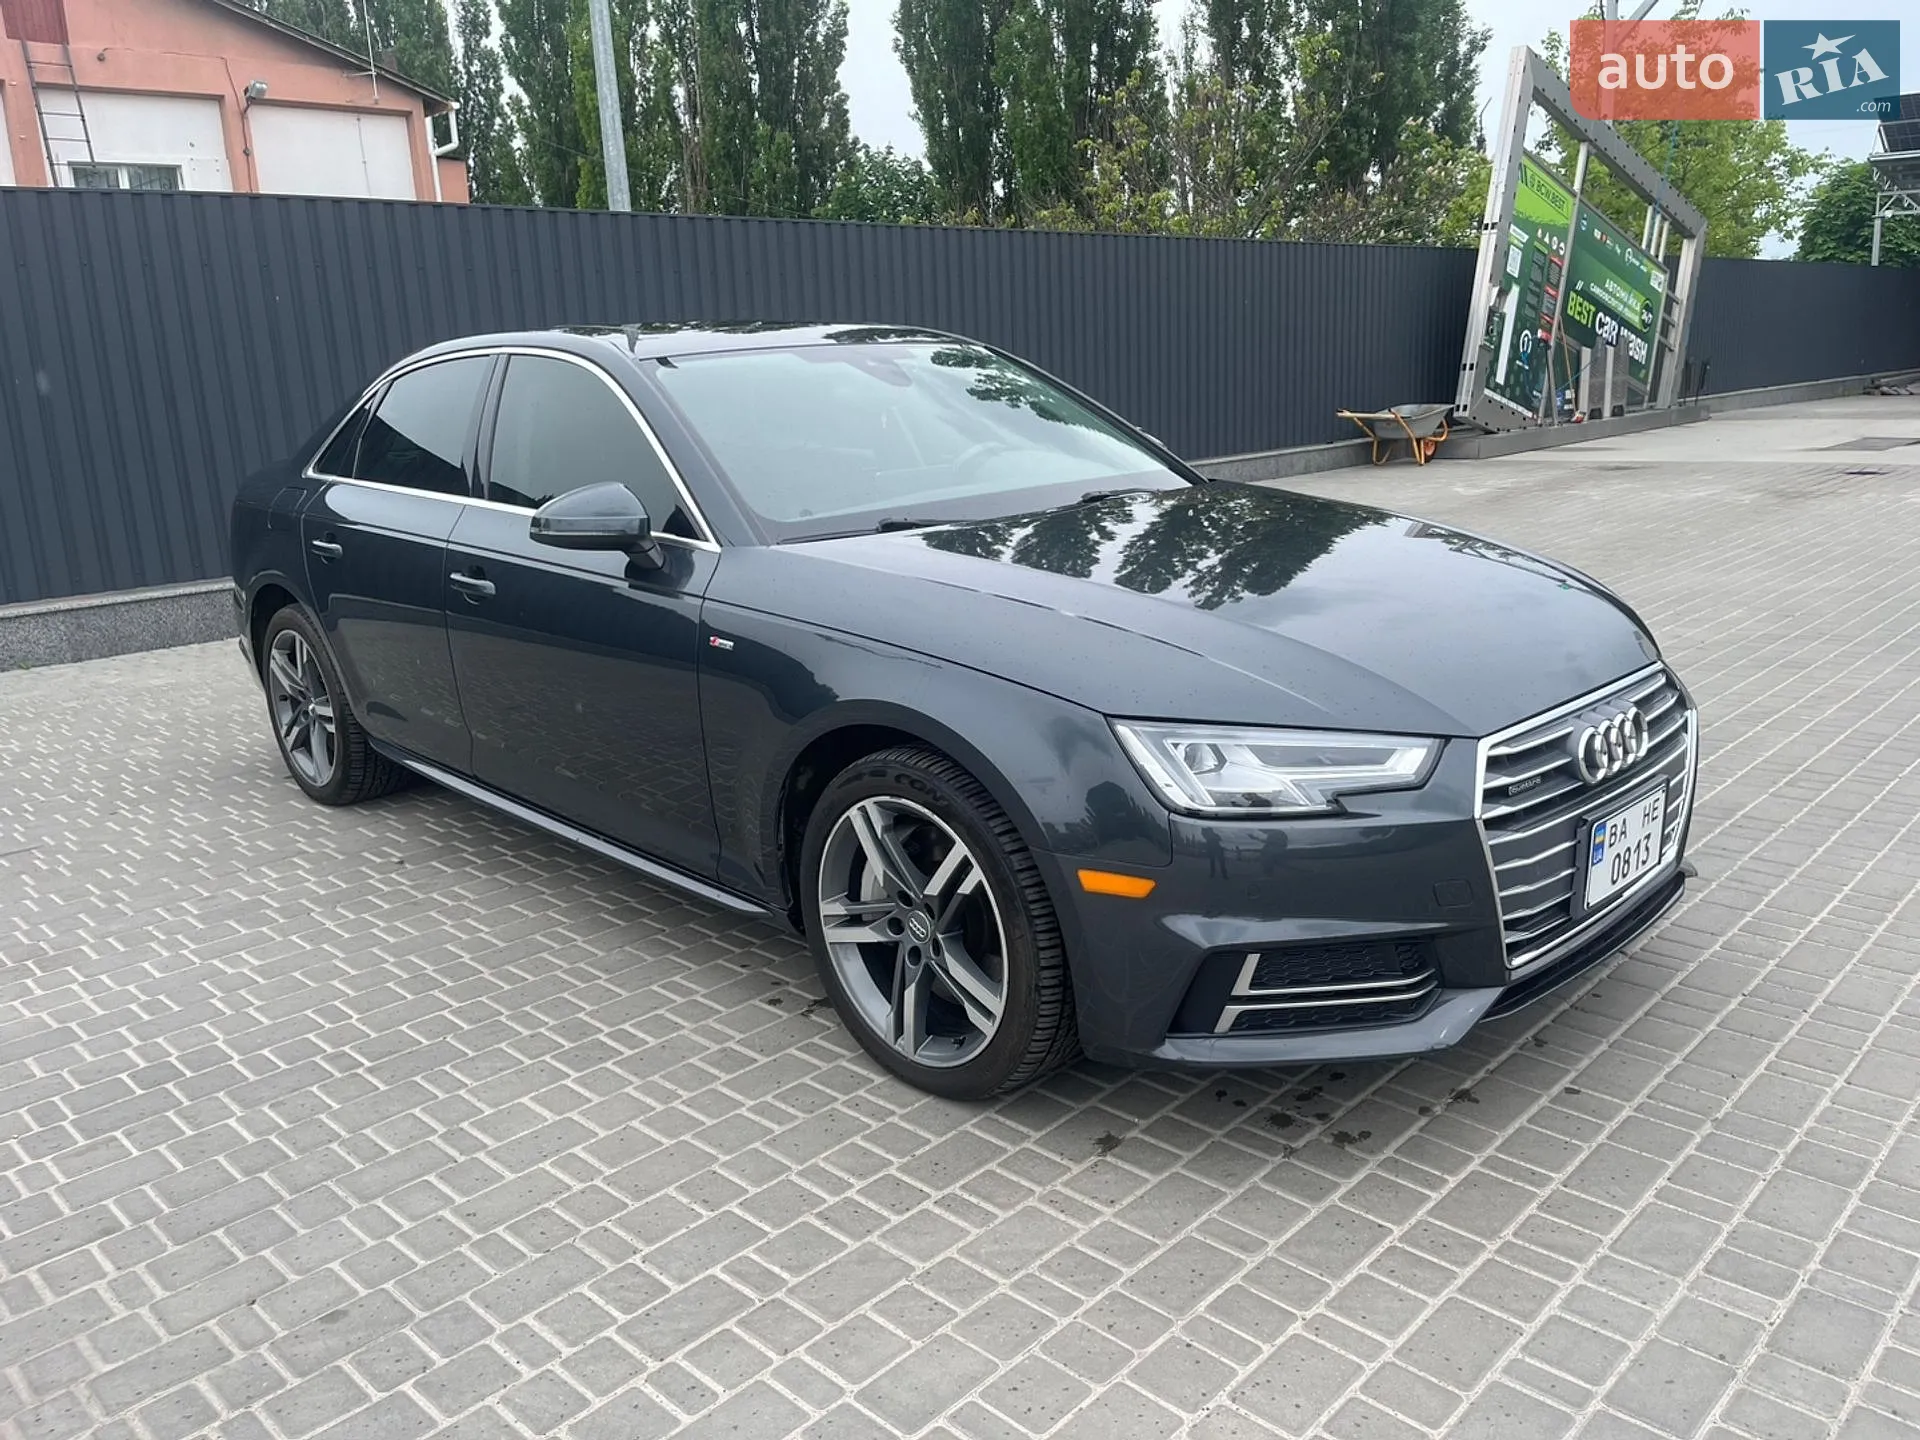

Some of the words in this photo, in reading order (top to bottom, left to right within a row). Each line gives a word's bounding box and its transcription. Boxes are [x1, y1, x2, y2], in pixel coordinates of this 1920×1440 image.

[1567, 291, 1596, 329] BEST
[1609, 817, 1628, 848] BA
[1642, 797, 1660, 828] HE
[1611, 832, 1651, 886] 0813
